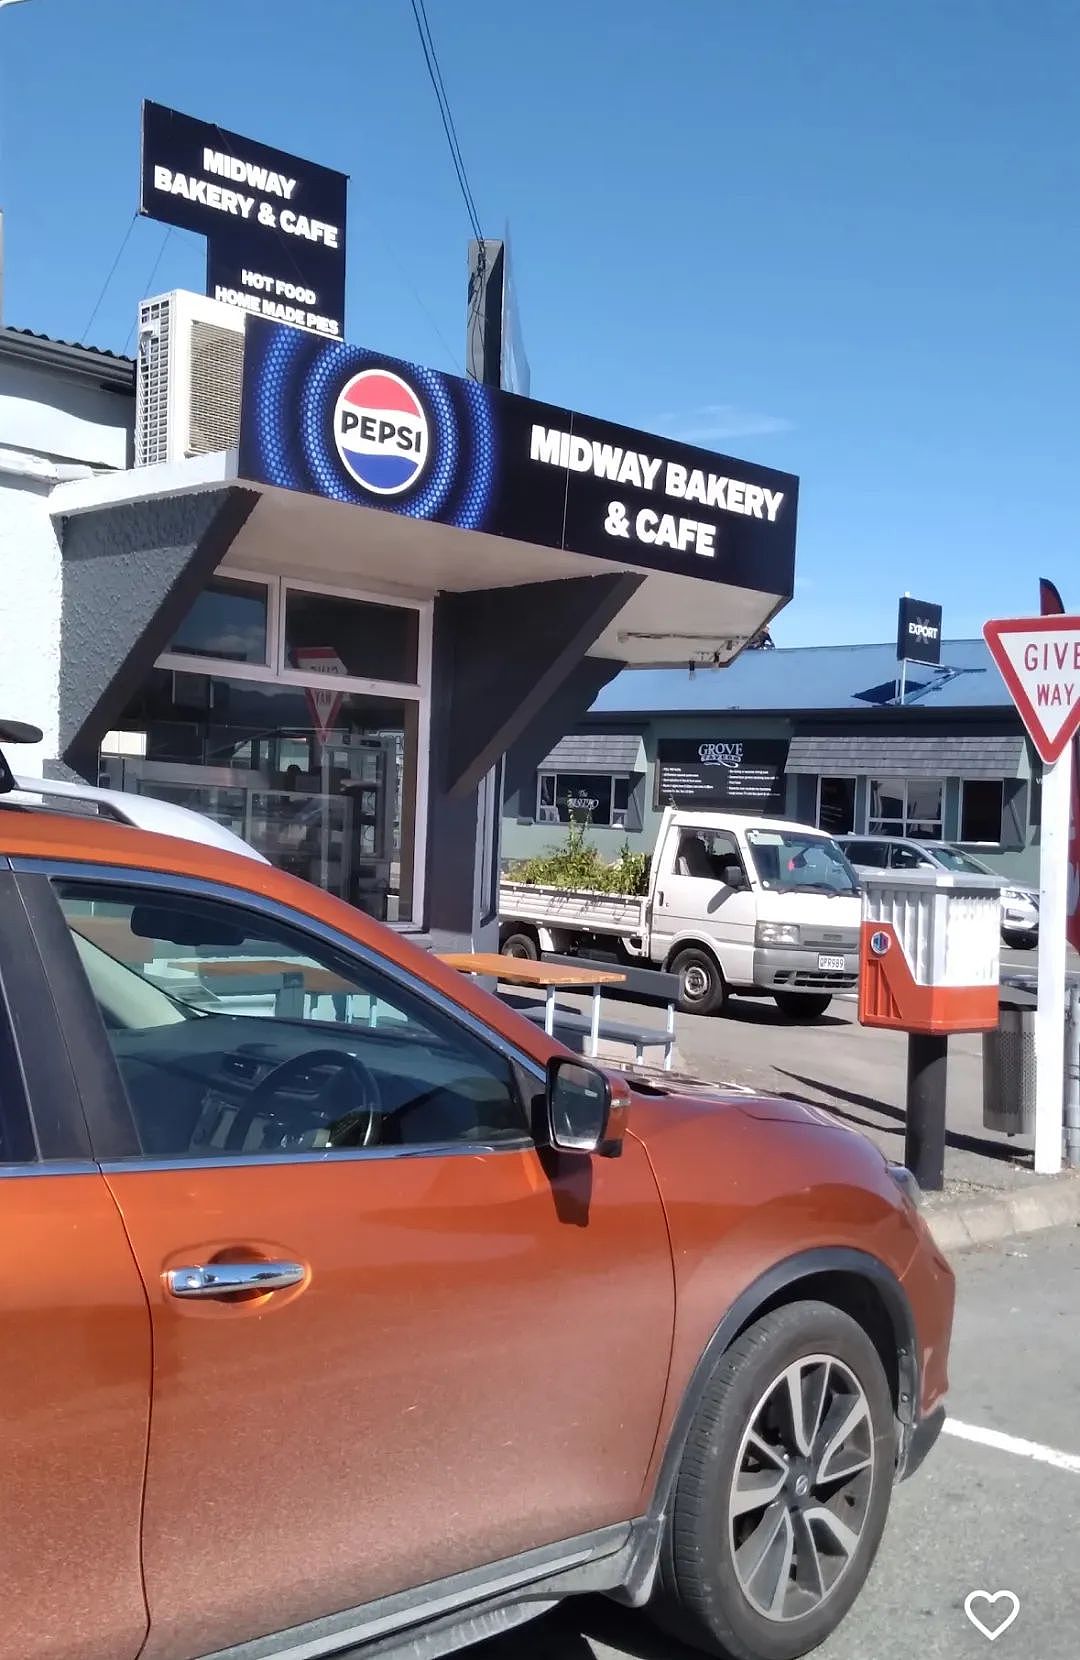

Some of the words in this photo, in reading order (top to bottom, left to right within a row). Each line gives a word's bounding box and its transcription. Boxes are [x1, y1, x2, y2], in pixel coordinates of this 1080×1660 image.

[203, 147, 296, 200] MIDWAY
[154, 165, 255, 219] BAKERY
[257, 202, 277, 228] &
[279, 209, 339, 249] CAFE
[241, 268, 275, 292] HOT
[275, 279, 317, 305] FOOD
[215, 285, 261, 312] HOME
[262, 298, 306, 326] MADE
[306, 311, 339, 335] PIES
[341, 409, 422, 454] PEPSI
[530, 424, 662, 490] MIDWAY
[665, 462, 785, 522] BAKERY
[604, 500, 630, 539] &
[636, 508, 718, 558] CAFE
[908, 622, 938, 639] EXPORT
[1024, 641, 1080, 671] GIVE
[1037, 683, 1074, 706] WAY
[698, 742, 743, 757] GROVE
